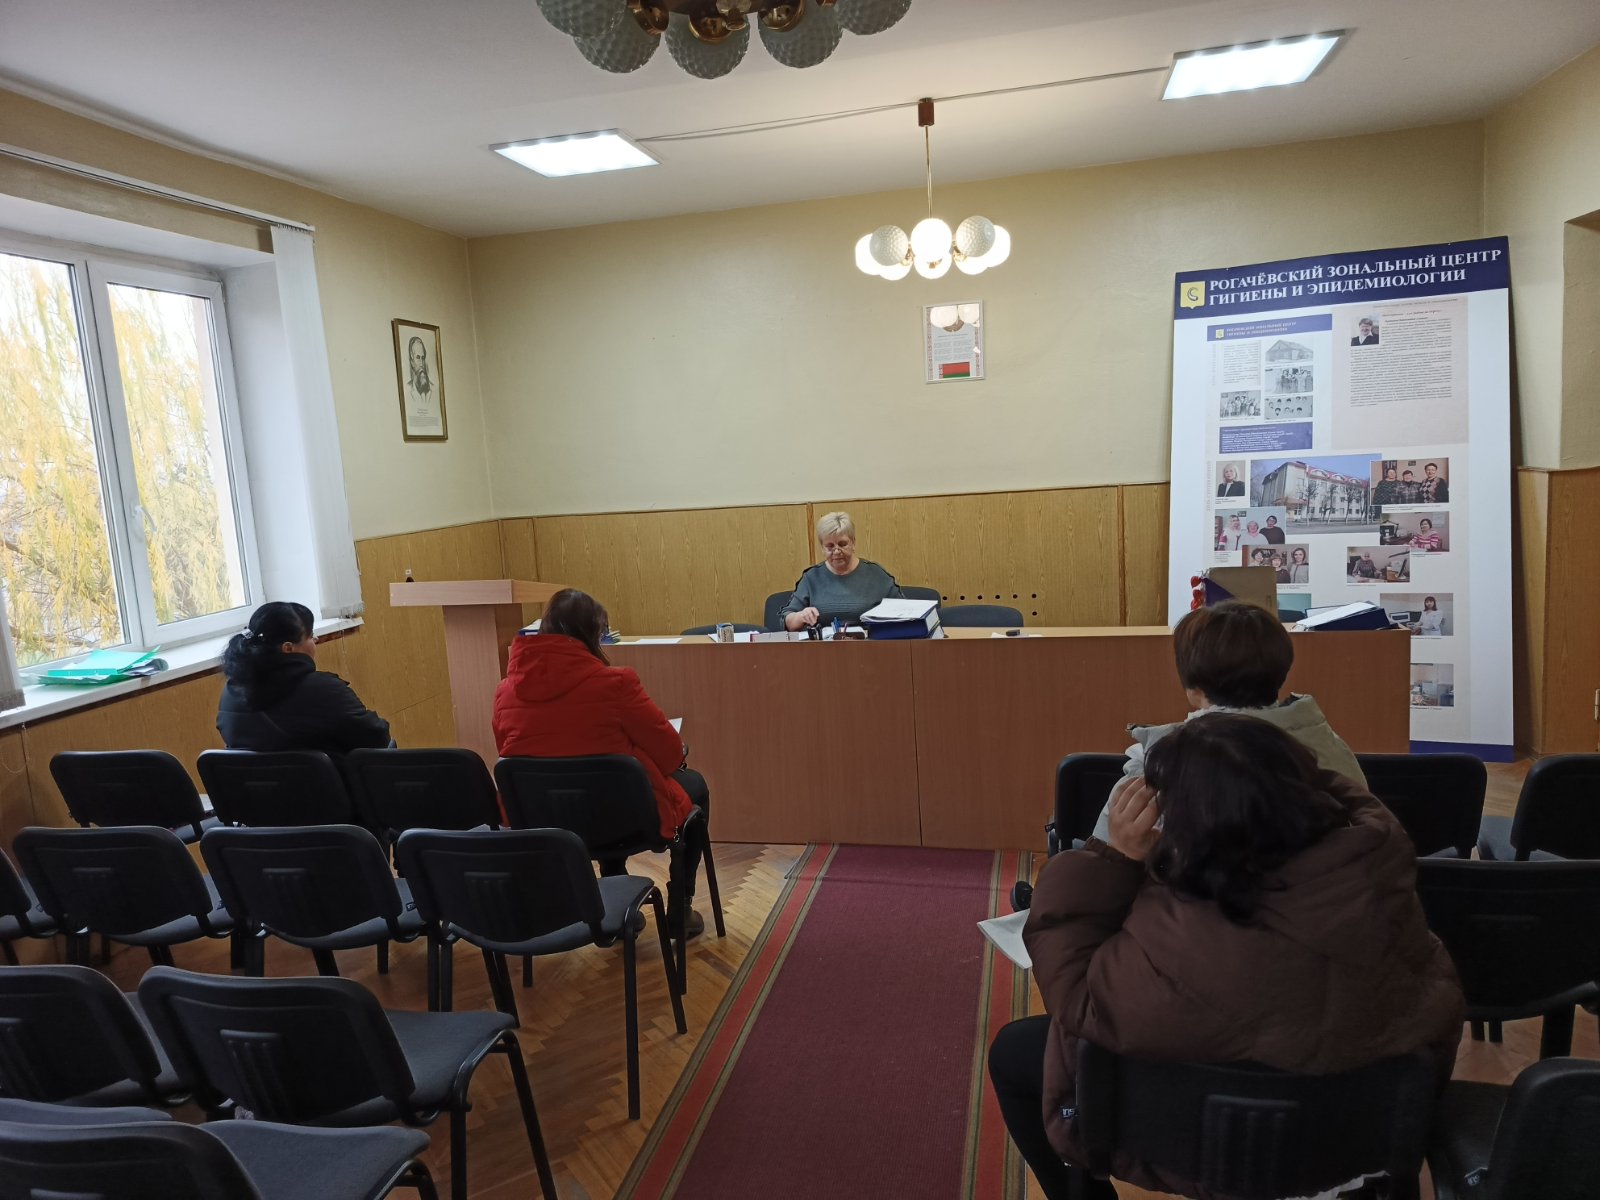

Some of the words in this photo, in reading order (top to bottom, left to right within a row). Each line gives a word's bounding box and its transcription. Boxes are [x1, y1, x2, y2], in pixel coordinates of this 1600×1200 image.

[1209, 288, 1287, 306] ГИГИЕНЫ
[1292, 285, 1303, 297] И
[1307, 269, 1467, 295] ЭПИДЕМИОЛОГИИ
[1210, 265, 1323, 291] РОГАЧЁВСКИЙ
[1327, 254, 1437, 278] ЗОНАЛЬНЫЙ
[1441, 249, 1502, 267] ЦЕНТР
